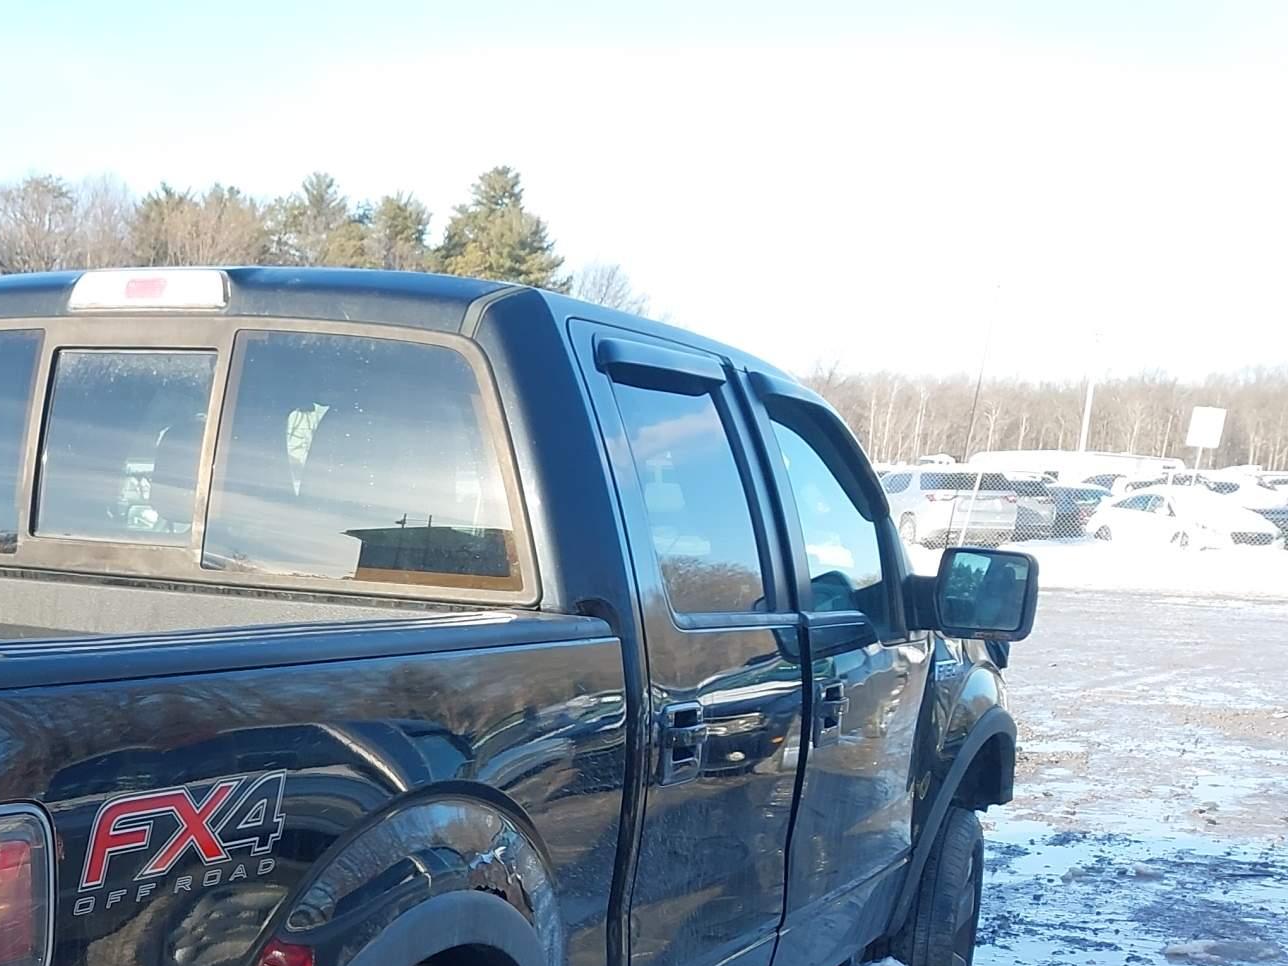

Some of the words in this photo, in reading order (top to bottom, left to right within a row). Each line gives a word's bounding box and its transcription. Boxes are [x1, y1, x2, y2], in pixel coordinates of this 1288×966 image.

[78, 769, 288, 893] FX4
[73, 883, 157, 916] OFF
[173, 859, 276, 894] ROAD
